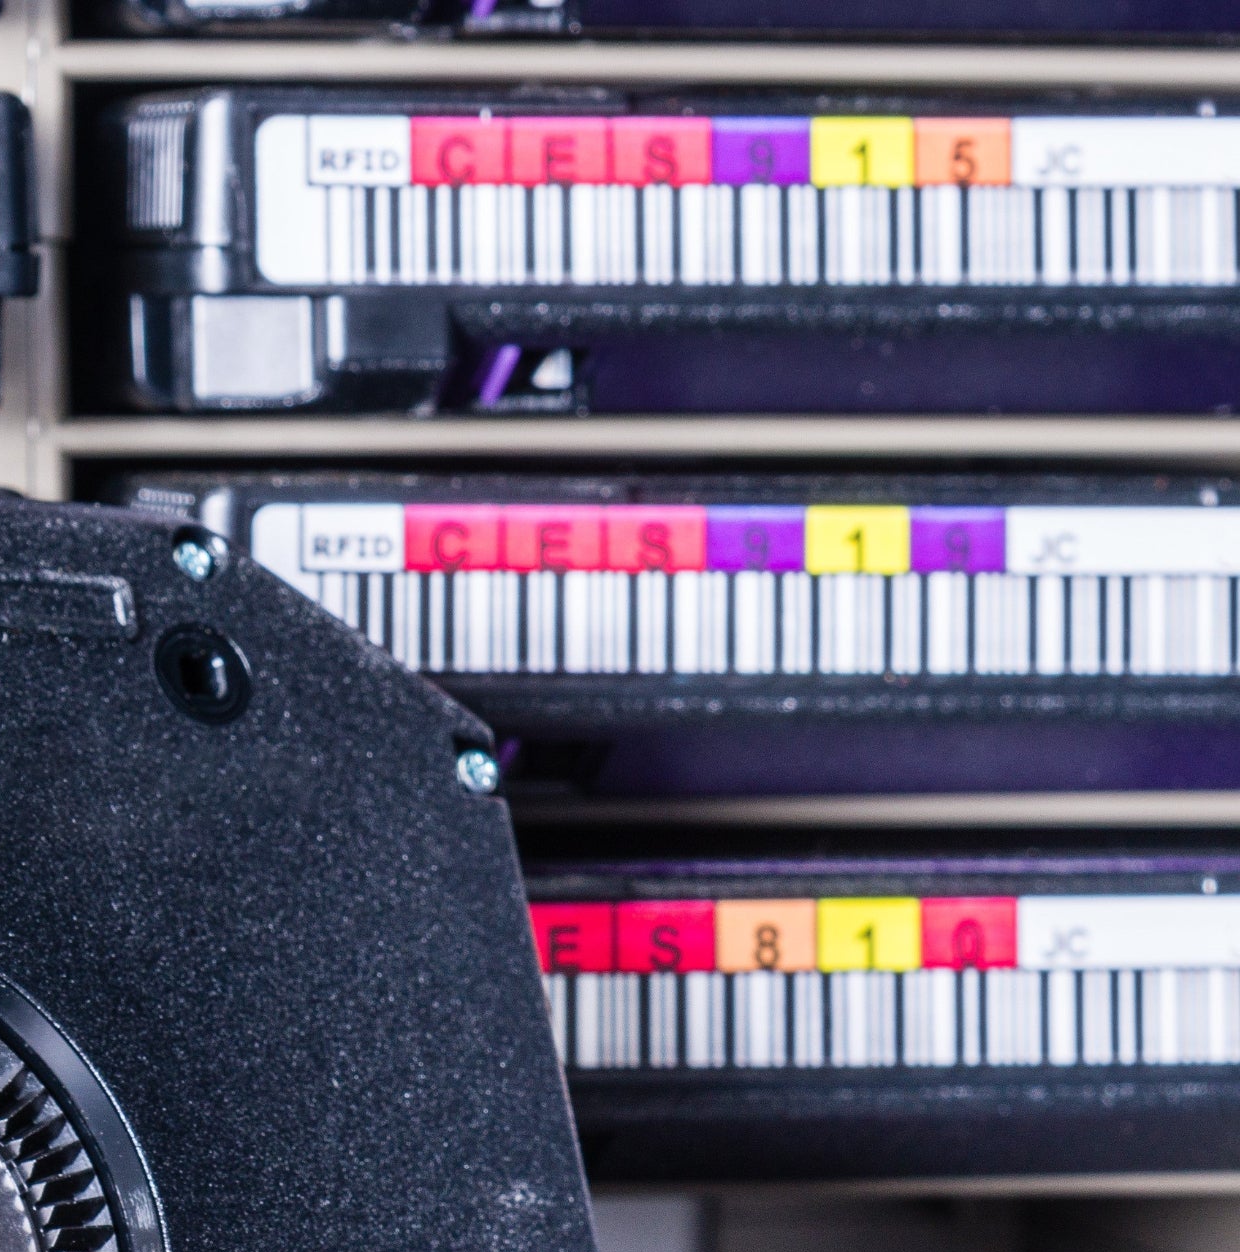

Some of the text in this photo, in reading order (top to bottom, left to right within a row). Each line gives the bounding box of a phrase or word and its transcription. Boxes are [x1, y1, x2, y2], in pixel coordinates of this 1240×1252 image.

[319, 149, 399, 172] RFID
[1037, 145, 1081, 176] JC
[312, 535, 394, 558] RFID
[1033, 533, 1079, 564] JC
[1045, 927, 1089, 957] JC
